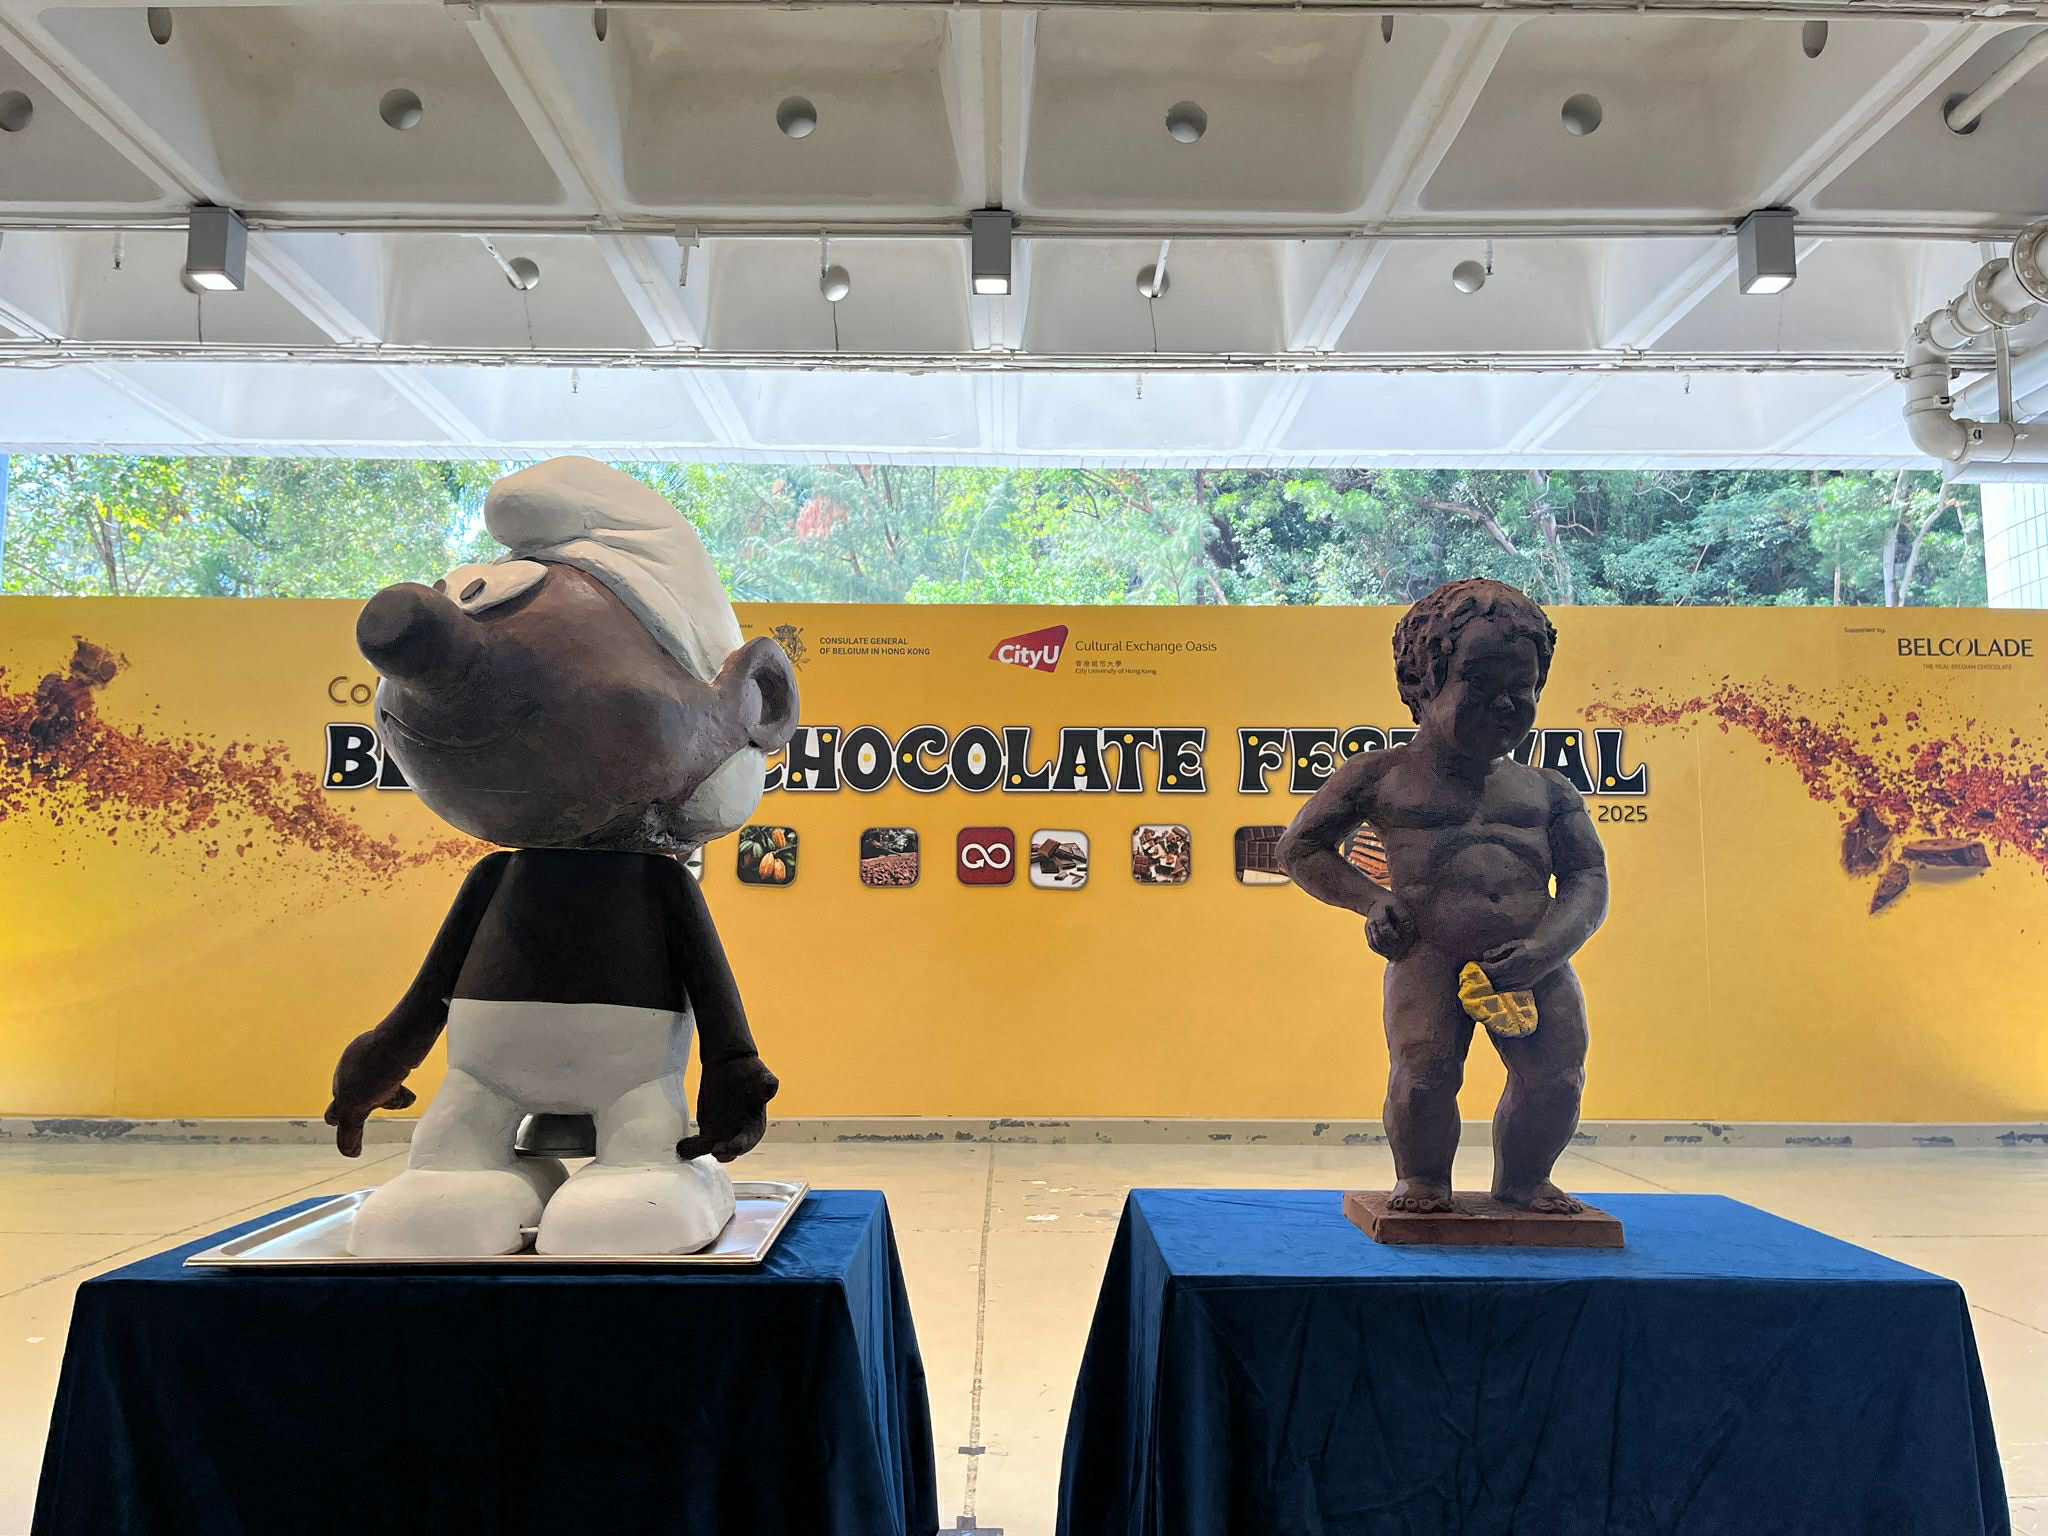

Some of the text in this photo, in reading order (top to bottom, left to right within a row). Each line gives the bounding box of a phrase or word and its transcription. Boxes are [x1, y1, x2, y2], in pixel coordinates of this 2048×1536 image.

[819, 636, 908, 645] CONSULATE GENERAL
[1075, 640, 1218, 655] Cultural Exchange Oasis
[1897, 638, 2035, 657] BELCOLADE
[819, 647, 931, 656] OF BELGIUM IN HONG KONG
[998, 644, 1060, 668] CityU
[764, 724, 1207, 794] HOCOLATE
[1597, 805, 1648, 822] 2025
